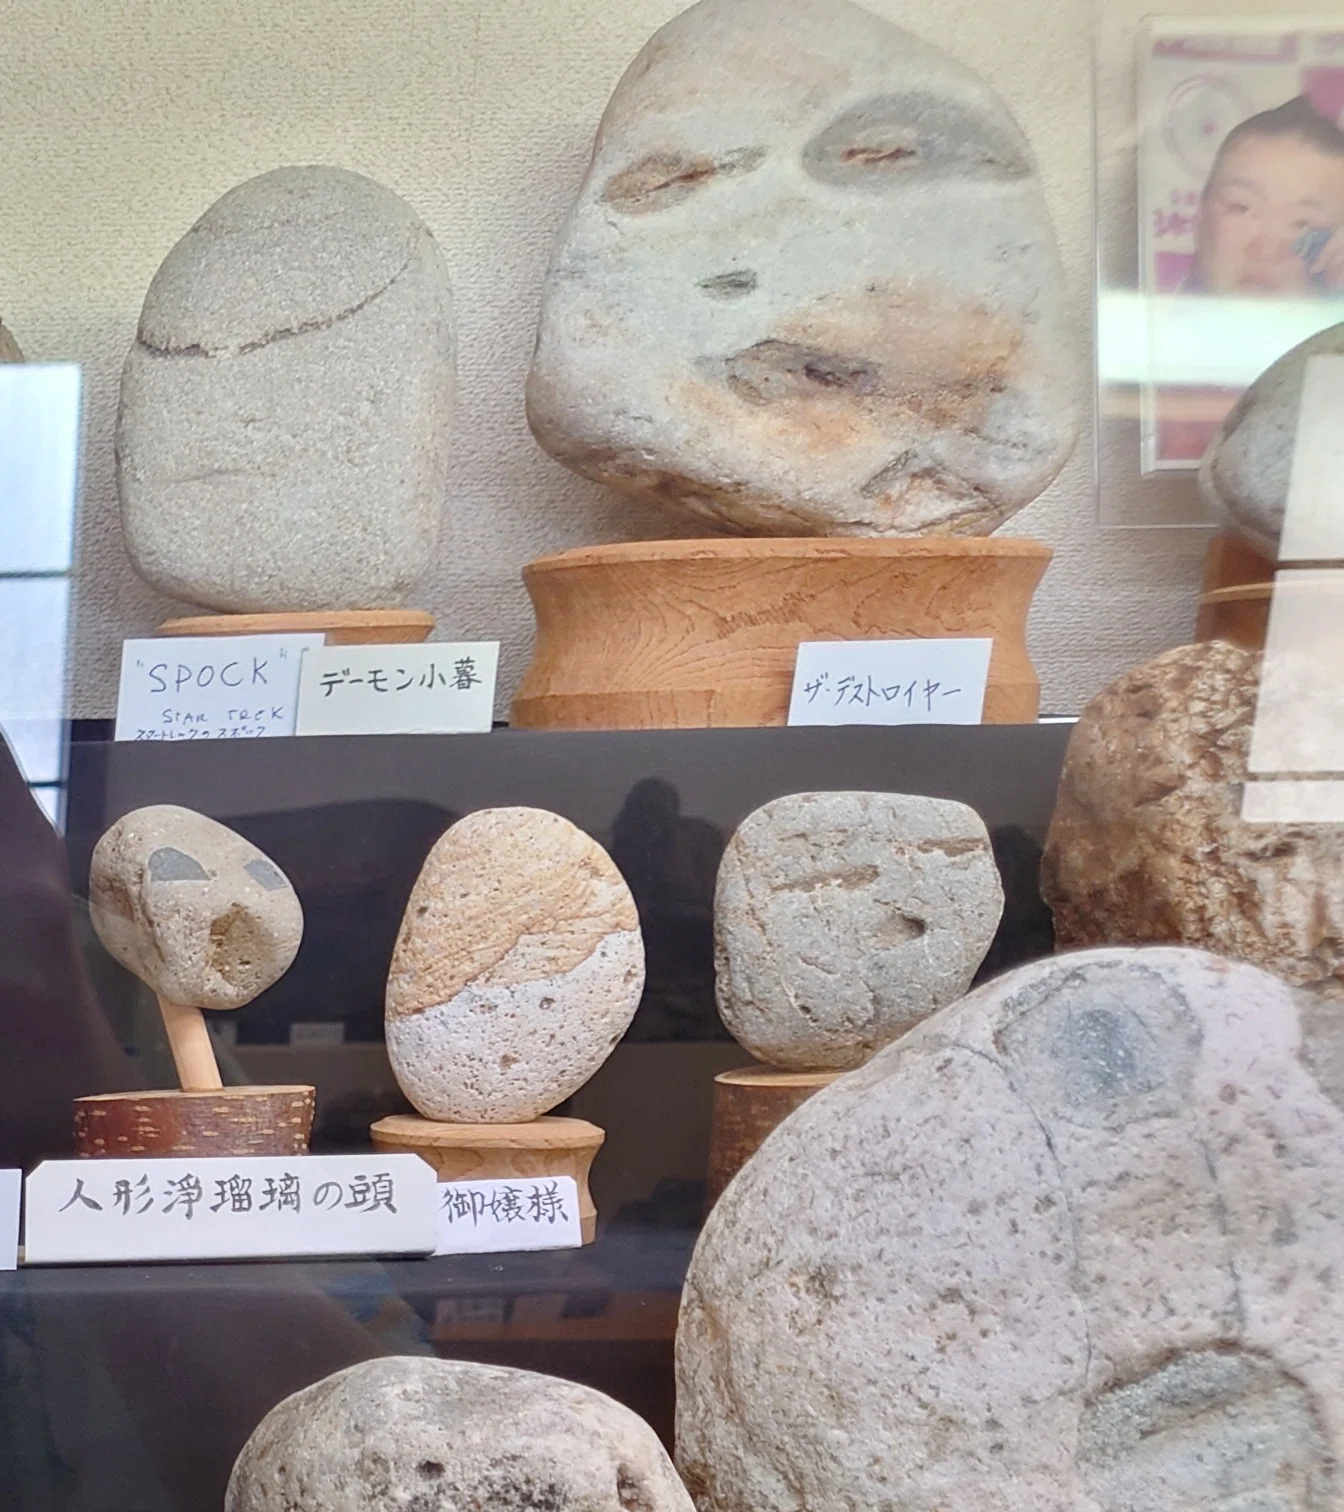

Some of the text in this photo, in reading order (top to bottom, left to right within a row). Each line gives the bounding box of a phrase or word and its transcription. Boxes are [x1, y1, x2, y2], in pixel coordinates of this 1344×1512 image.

[319, 655, 483, 697] デーモン小暮
